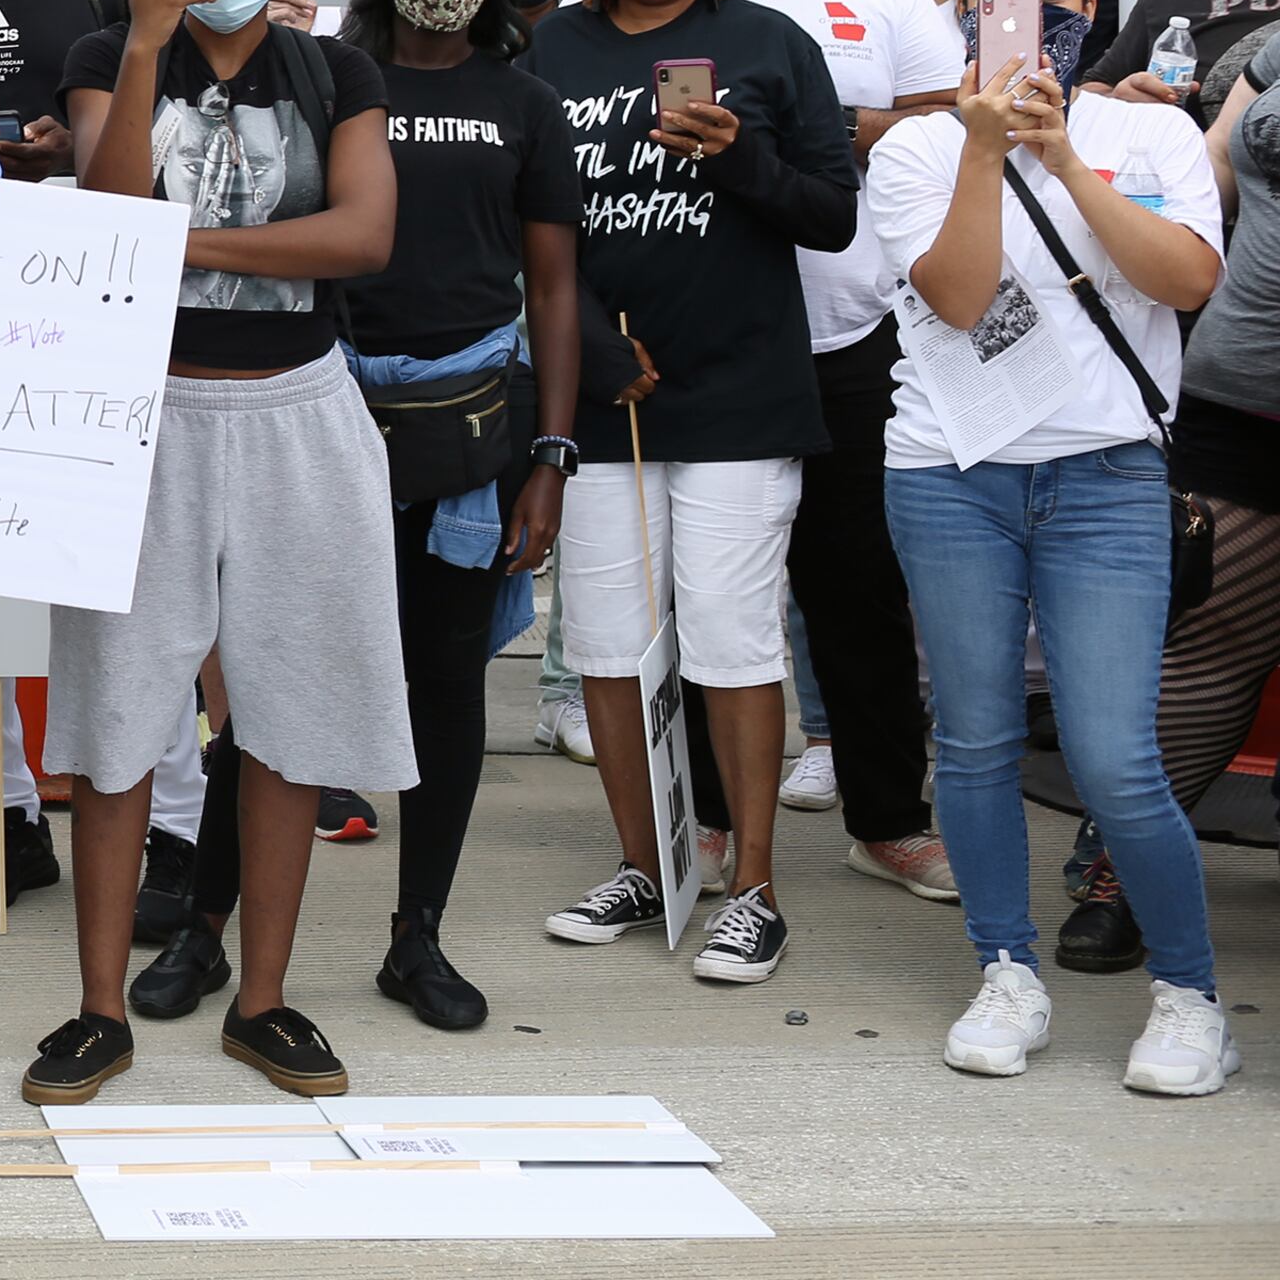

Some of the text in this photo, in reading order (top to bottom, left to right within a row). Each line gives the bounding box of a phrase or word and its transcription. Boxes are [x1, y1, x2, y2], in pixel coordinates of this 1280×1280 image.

[388, 116, 505, 148] IS FAITHFUL
[582, 188, 715, 237] HASHTAG
